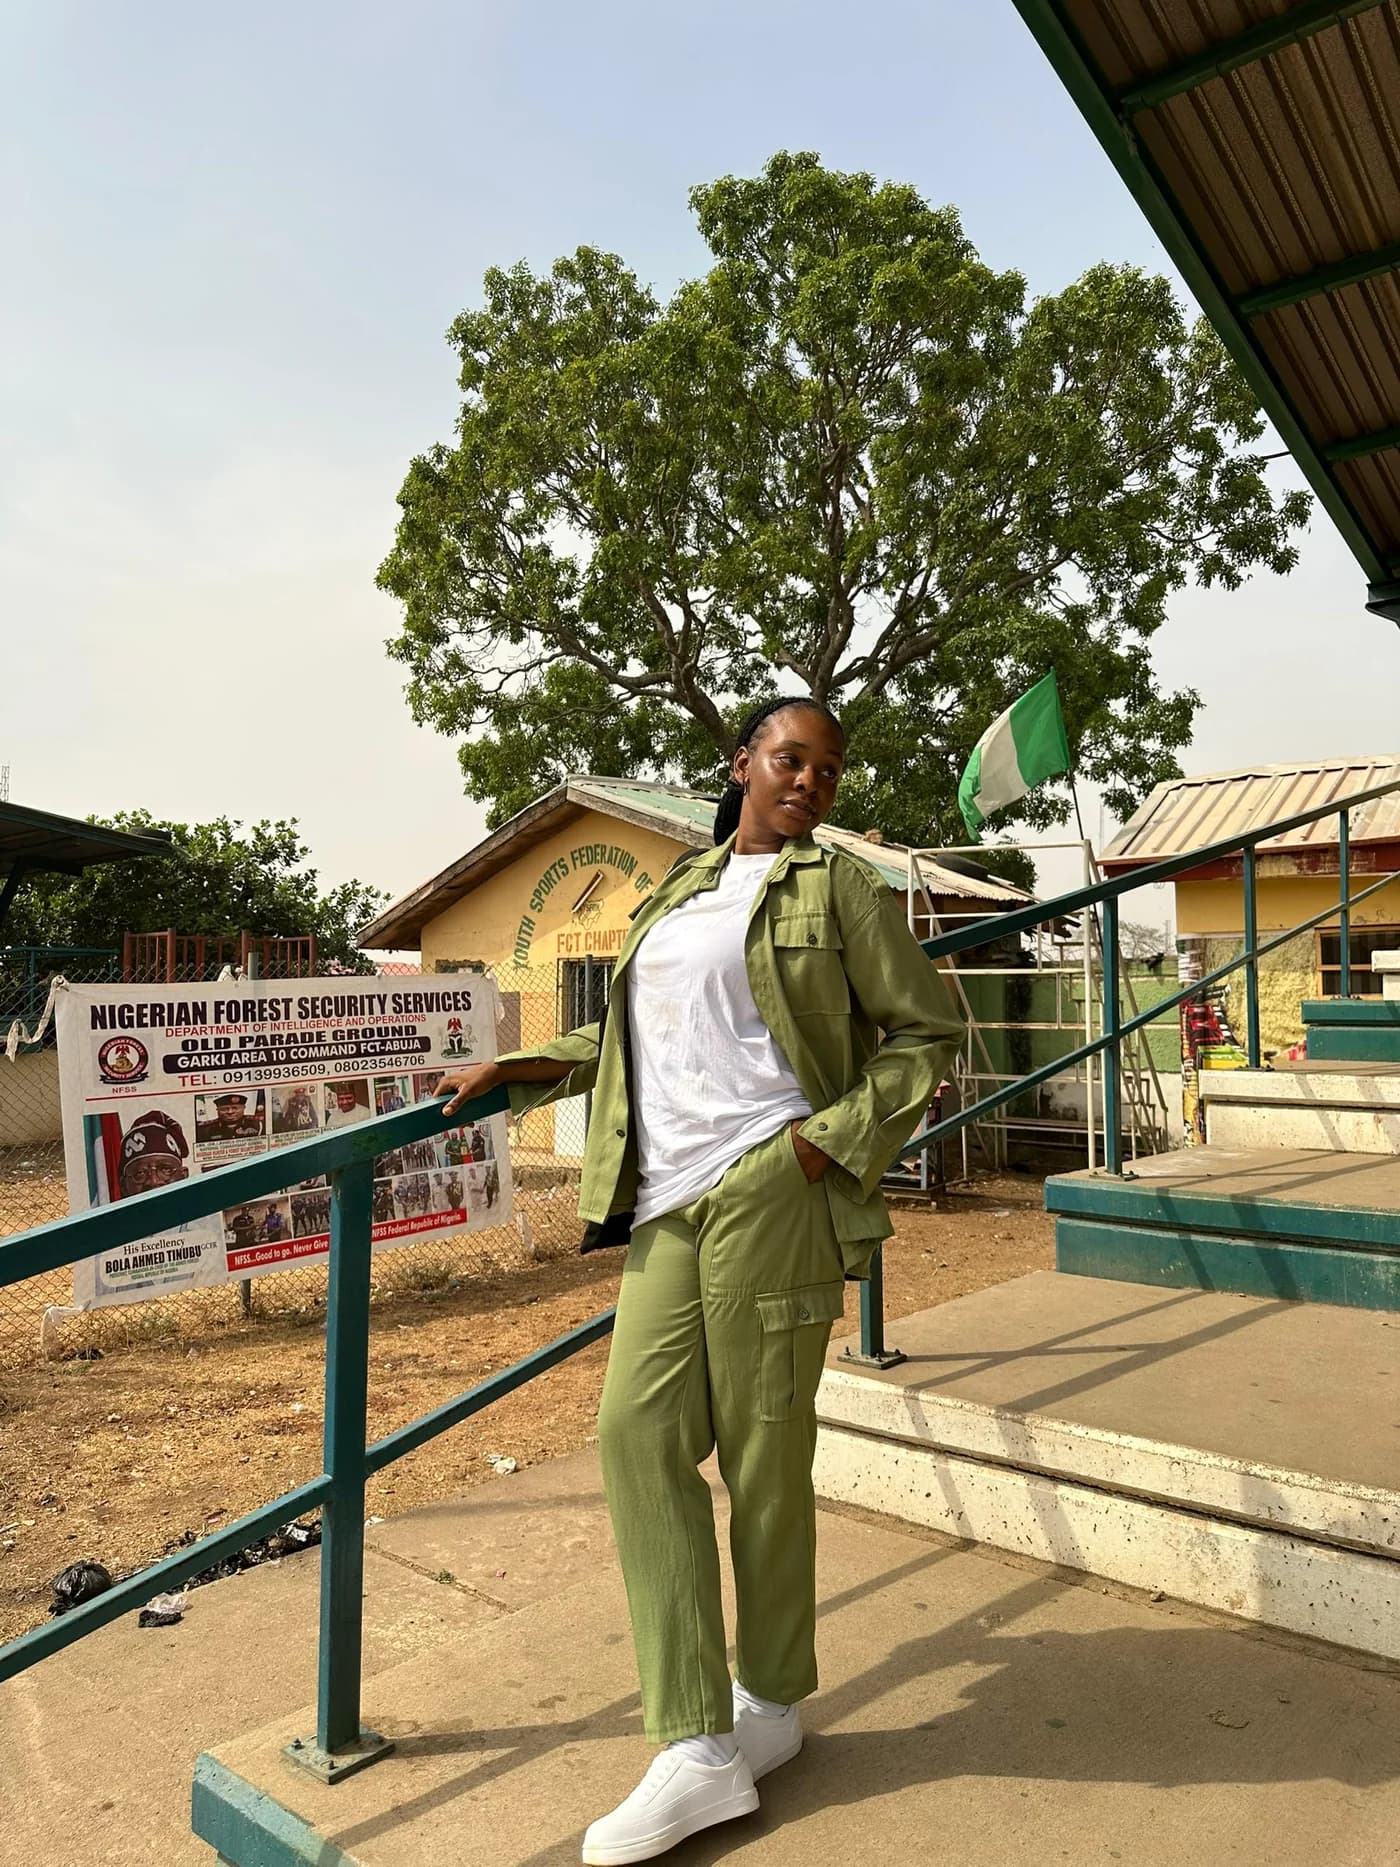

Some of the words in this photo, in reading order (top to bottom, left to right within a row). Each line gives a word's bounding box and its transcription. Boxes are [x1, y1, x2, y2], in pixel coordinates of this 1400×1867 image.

[513, 915, 536, 970] YOUTH
[529, 857, 569, 913] SPORTS
[570, 843, 638, 879] FEDERATION
[634, 871, 654, 893] OF
[557, 932, 582, 954] FCT
[90, 1001, 207, 1030] NIGERIAN
[214, 998, 293, 1025] FOREST
[297, 993, 388, 1020] SECURITY
[392, 990, 472, 1014] SERVICES
[165, 1024, 249, 1038] DEPARTMENT
[253, 1023, 267, 1033] OF
[271, 1018, 343, 1031] INTELLIGENCE
[345, 1017, 365, 1027] AND
[368, 1014, 426, 1025] OPERATIONS
[181, 1037, 231, 1052] OLD
[239, 1031, 327, 1048] PARADE
[332, 1025, 417, 1042] GROUND
[177, 1054, 226, 1069] GARKI
[230, 1051, 265, 1065] AREA
[271, 1049, 285, 1061] 10
[290, 1044, 356, 1060] COMMAND
[361, 1040, 421, 1055] FCT-ABUJA
[178, 1074, 217, 1087] TEL:
[223, 1064, 331, 1084] 09139936509,
[335, 1055, 425, 1073] 08023546706
[112, 1086, 137, 1094] NFSS
[387, 1222, 409, 1235] Federal
[410, 1217, 433, 1231] Republic
[434, 1215, 440, 1224] of
[124, 1245, 139, 1255] His
[141, 1238, 185, 1252] Excellency
[274, 1249, 280, 1257] to
[293, 1243, 312, 1254] Never
[313, 1239, 328, 1250] Give
[105, 1258, 131, 1274] BOLA
[132, 1251, 165, 1269] AHMED
[166, 1245, 202, 1262] TINUBU
